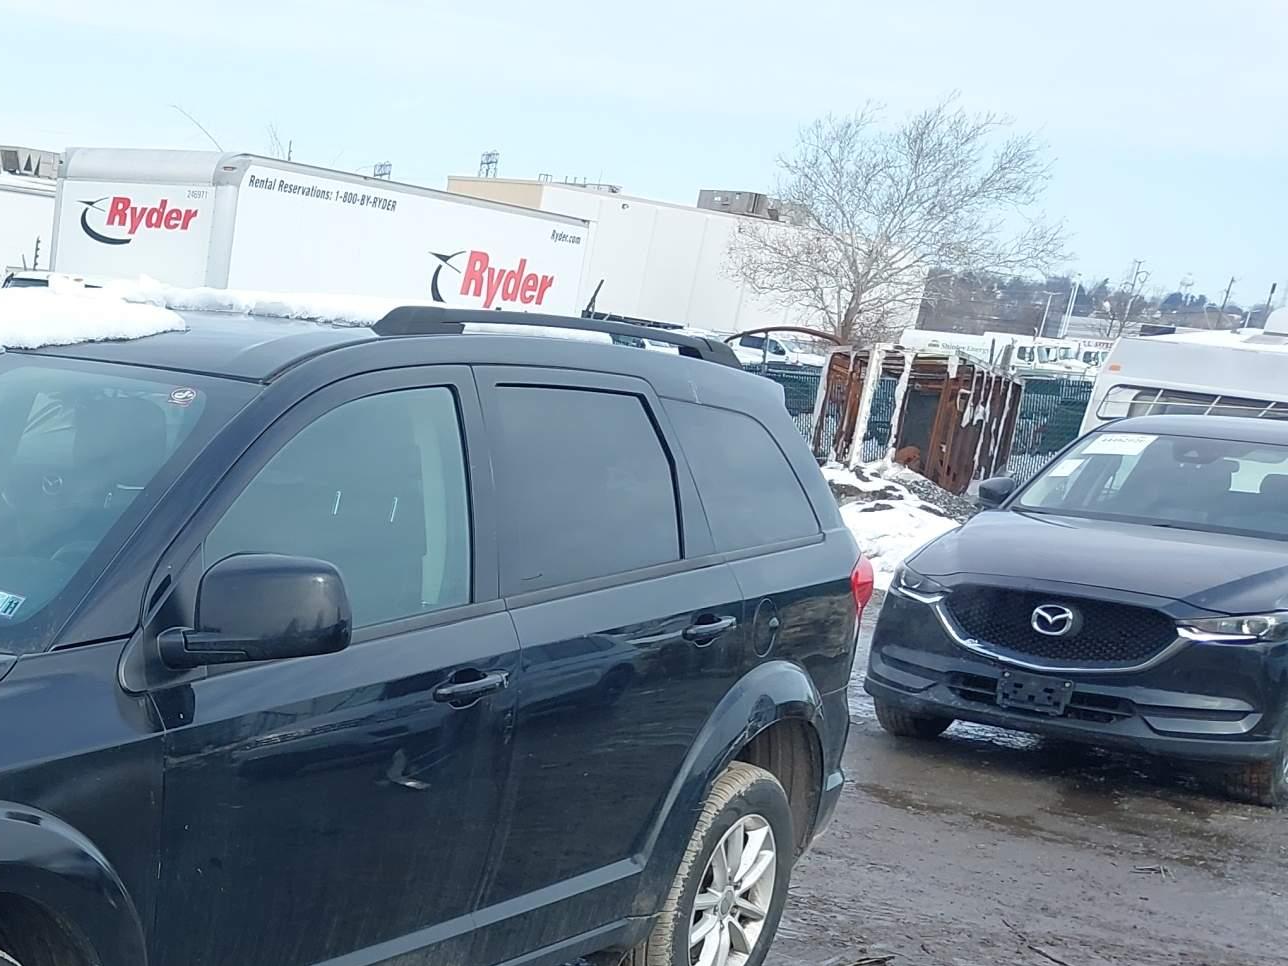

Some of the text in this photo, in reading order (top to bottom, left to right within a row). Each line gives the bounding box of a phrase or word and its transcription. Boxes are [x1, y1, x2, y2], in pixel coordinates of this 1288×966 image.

[248, 174, 398, 212] Rental Reservations: 1-800-BY-RYDER
[105, 196, 199, 235] Ryder
[550, 229, 582, 244] Ryder.com
[459, 249, 555, 309] Ryder
